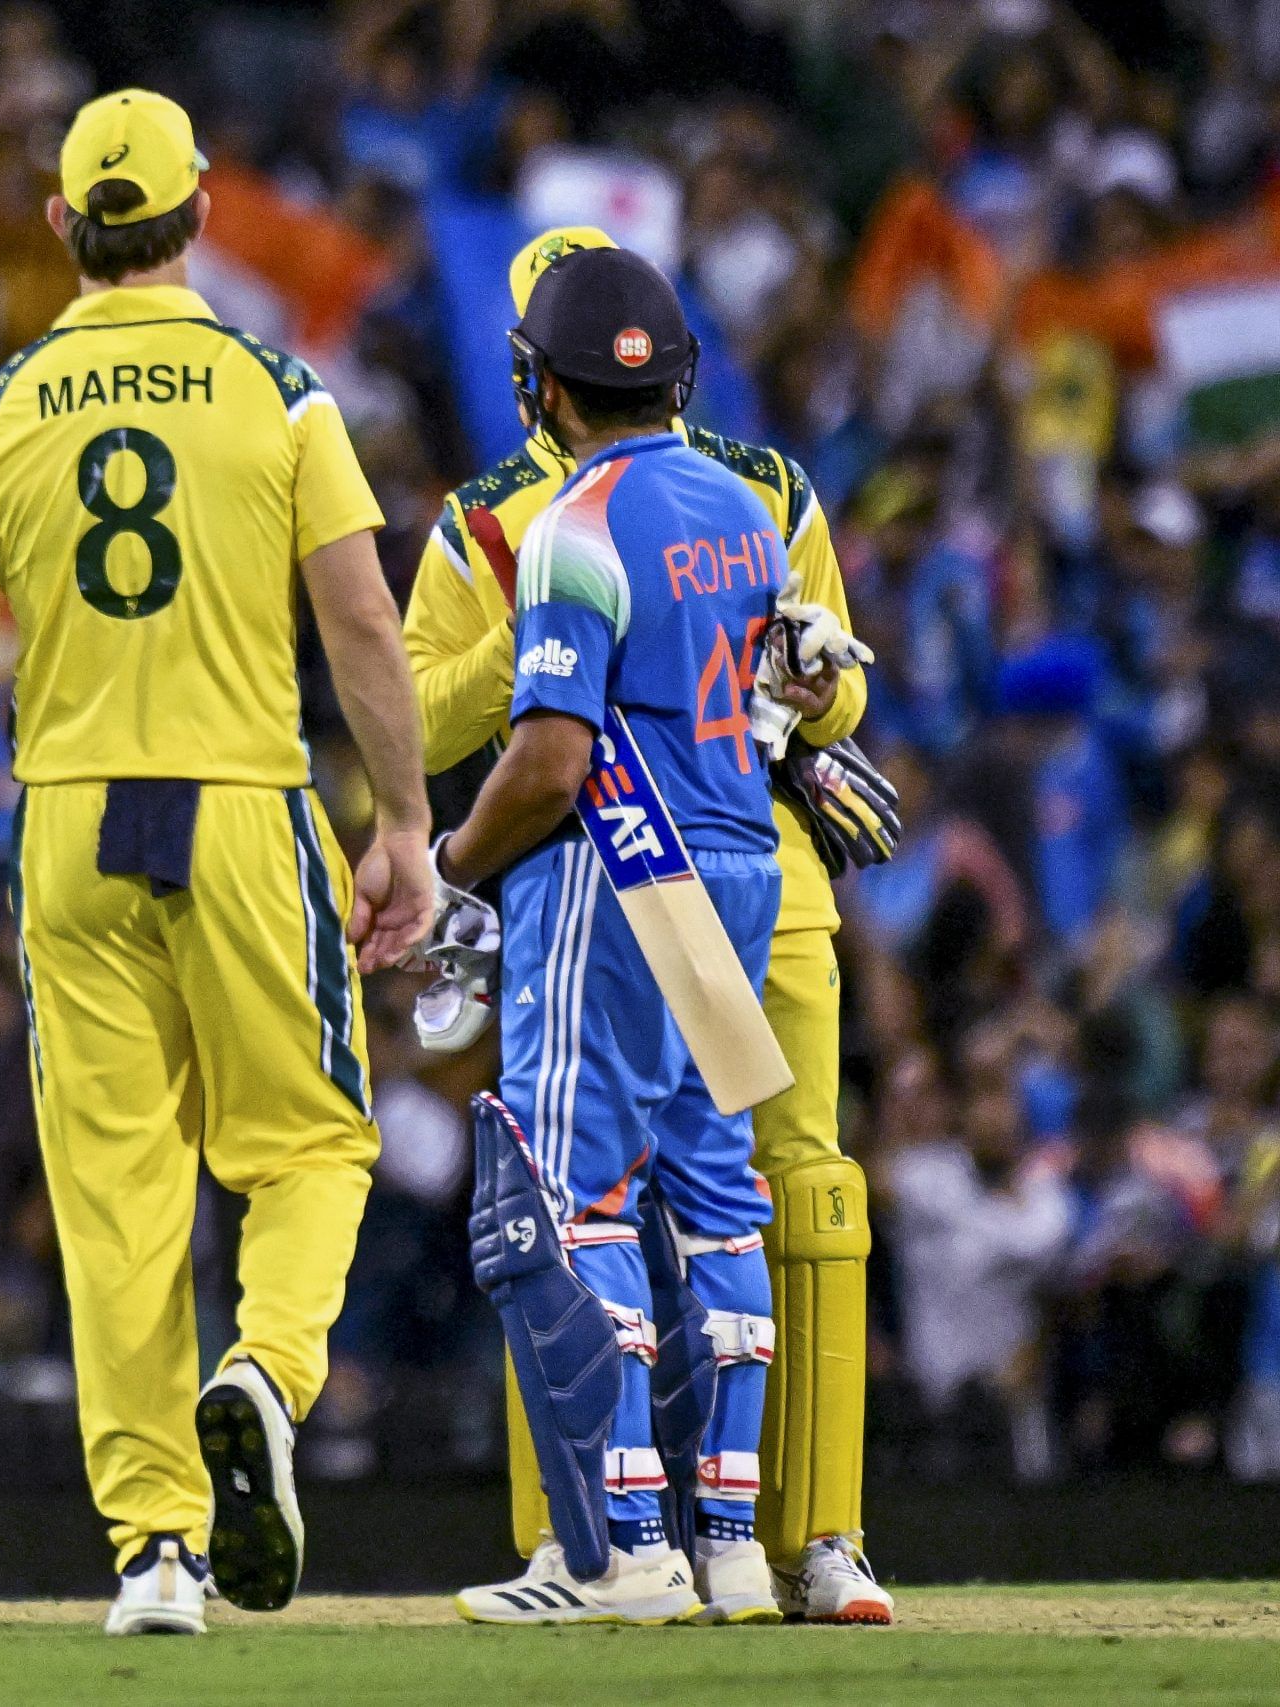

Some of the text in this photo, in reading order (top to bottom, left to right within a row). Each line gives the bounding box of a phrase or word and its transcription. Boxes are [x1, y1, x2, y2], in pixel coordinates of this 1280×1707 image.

[38, 364, 213, 420] MARSH
[75, 427, 183, 621] 8
[663, 530, 782, 601] ROHIT
